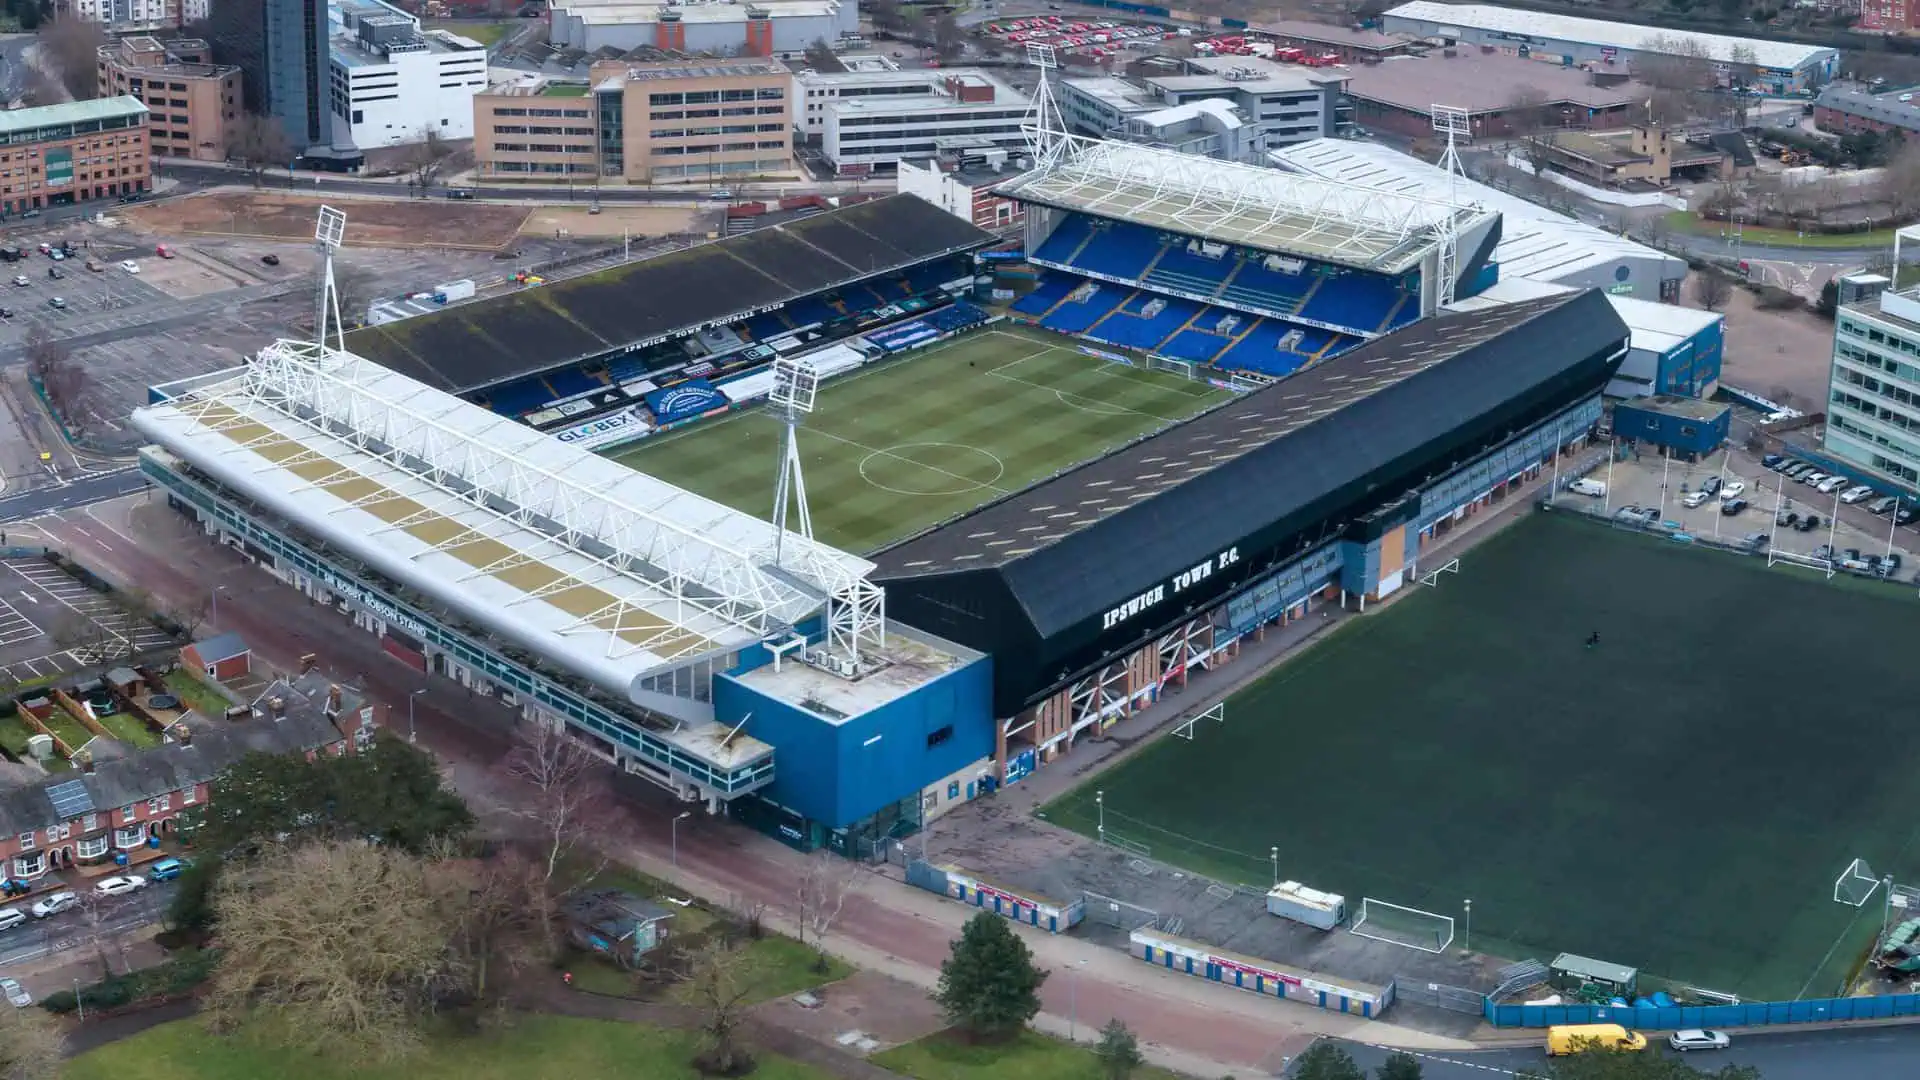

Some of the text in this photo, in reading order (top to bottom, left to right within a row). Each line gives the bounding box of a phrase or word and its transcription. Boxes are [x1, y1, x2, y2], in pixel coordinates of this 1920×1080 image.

[676, 326, 701, 338] TOWN
[711, 311, 755, 328] FOOTBALL
[762, 302, 785, 314] CLUB
[1103, 546, 1240, 630] IPSWICH TOWN F.C.
[400, 615, 426, 637] STAND
